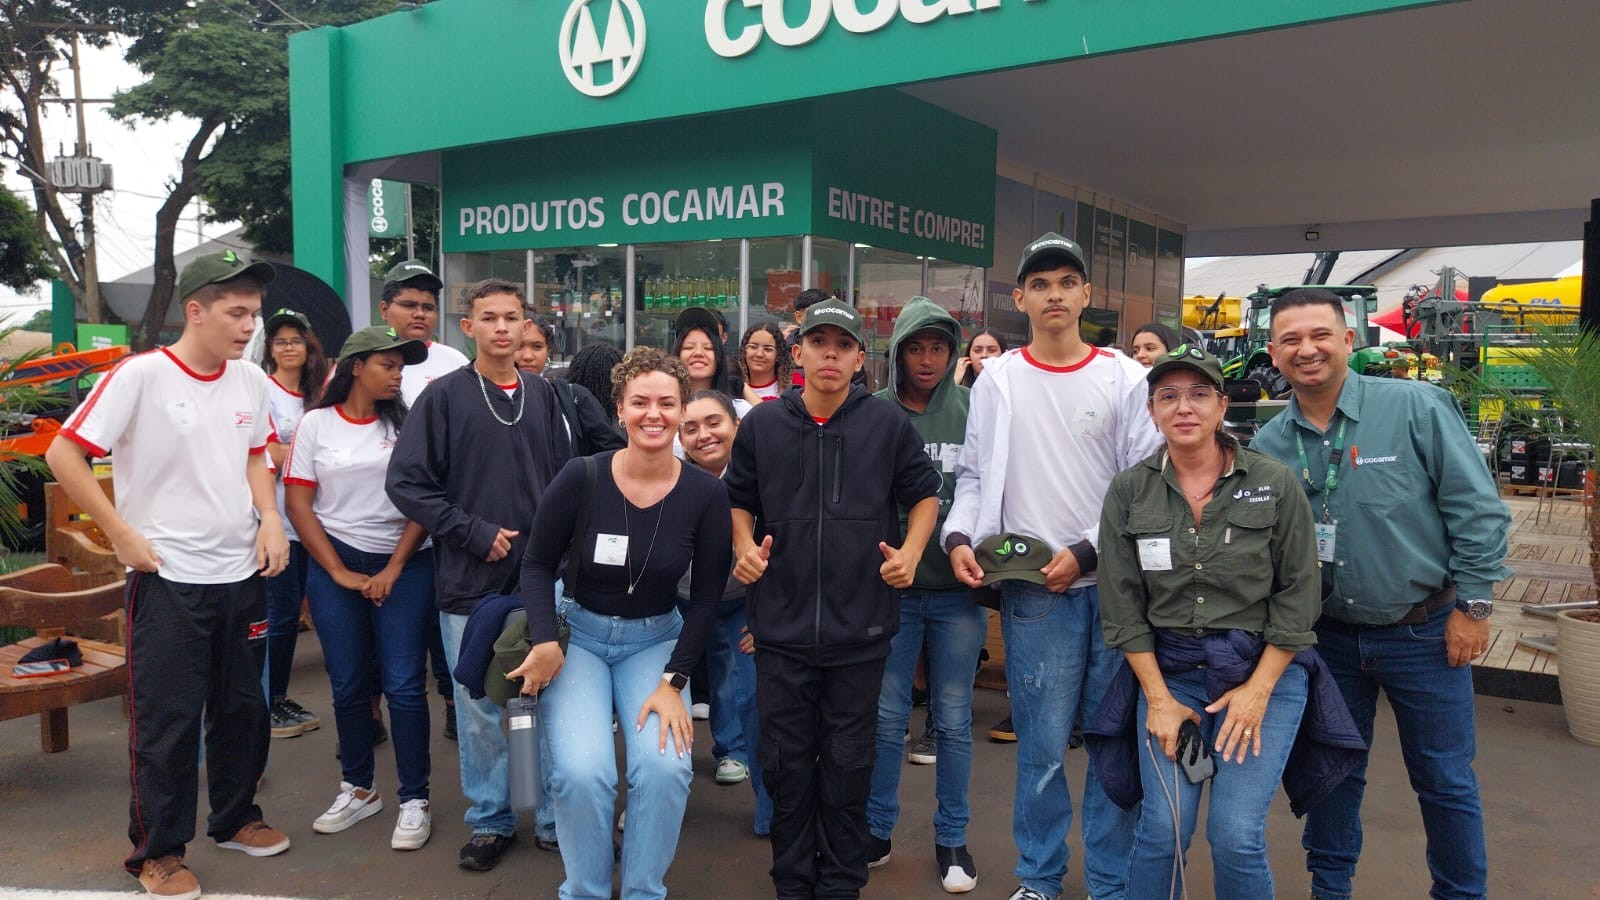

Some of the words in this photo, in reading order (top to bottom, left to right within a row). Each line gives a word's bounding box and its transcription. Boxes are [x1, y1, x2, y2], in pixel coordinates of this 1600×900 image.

[459, 197, 605, 236] PRODUTOS
[622, 182, 785, 226] COCAMAR
[828, 187, 894, 230] ENTRE
[899, 205, 910, 234] E
[914, 209, 985, 249] COMPRE!
[1530, 297, 1562, 306] PLA
[1364, 455, 1397, 464] cocamar
